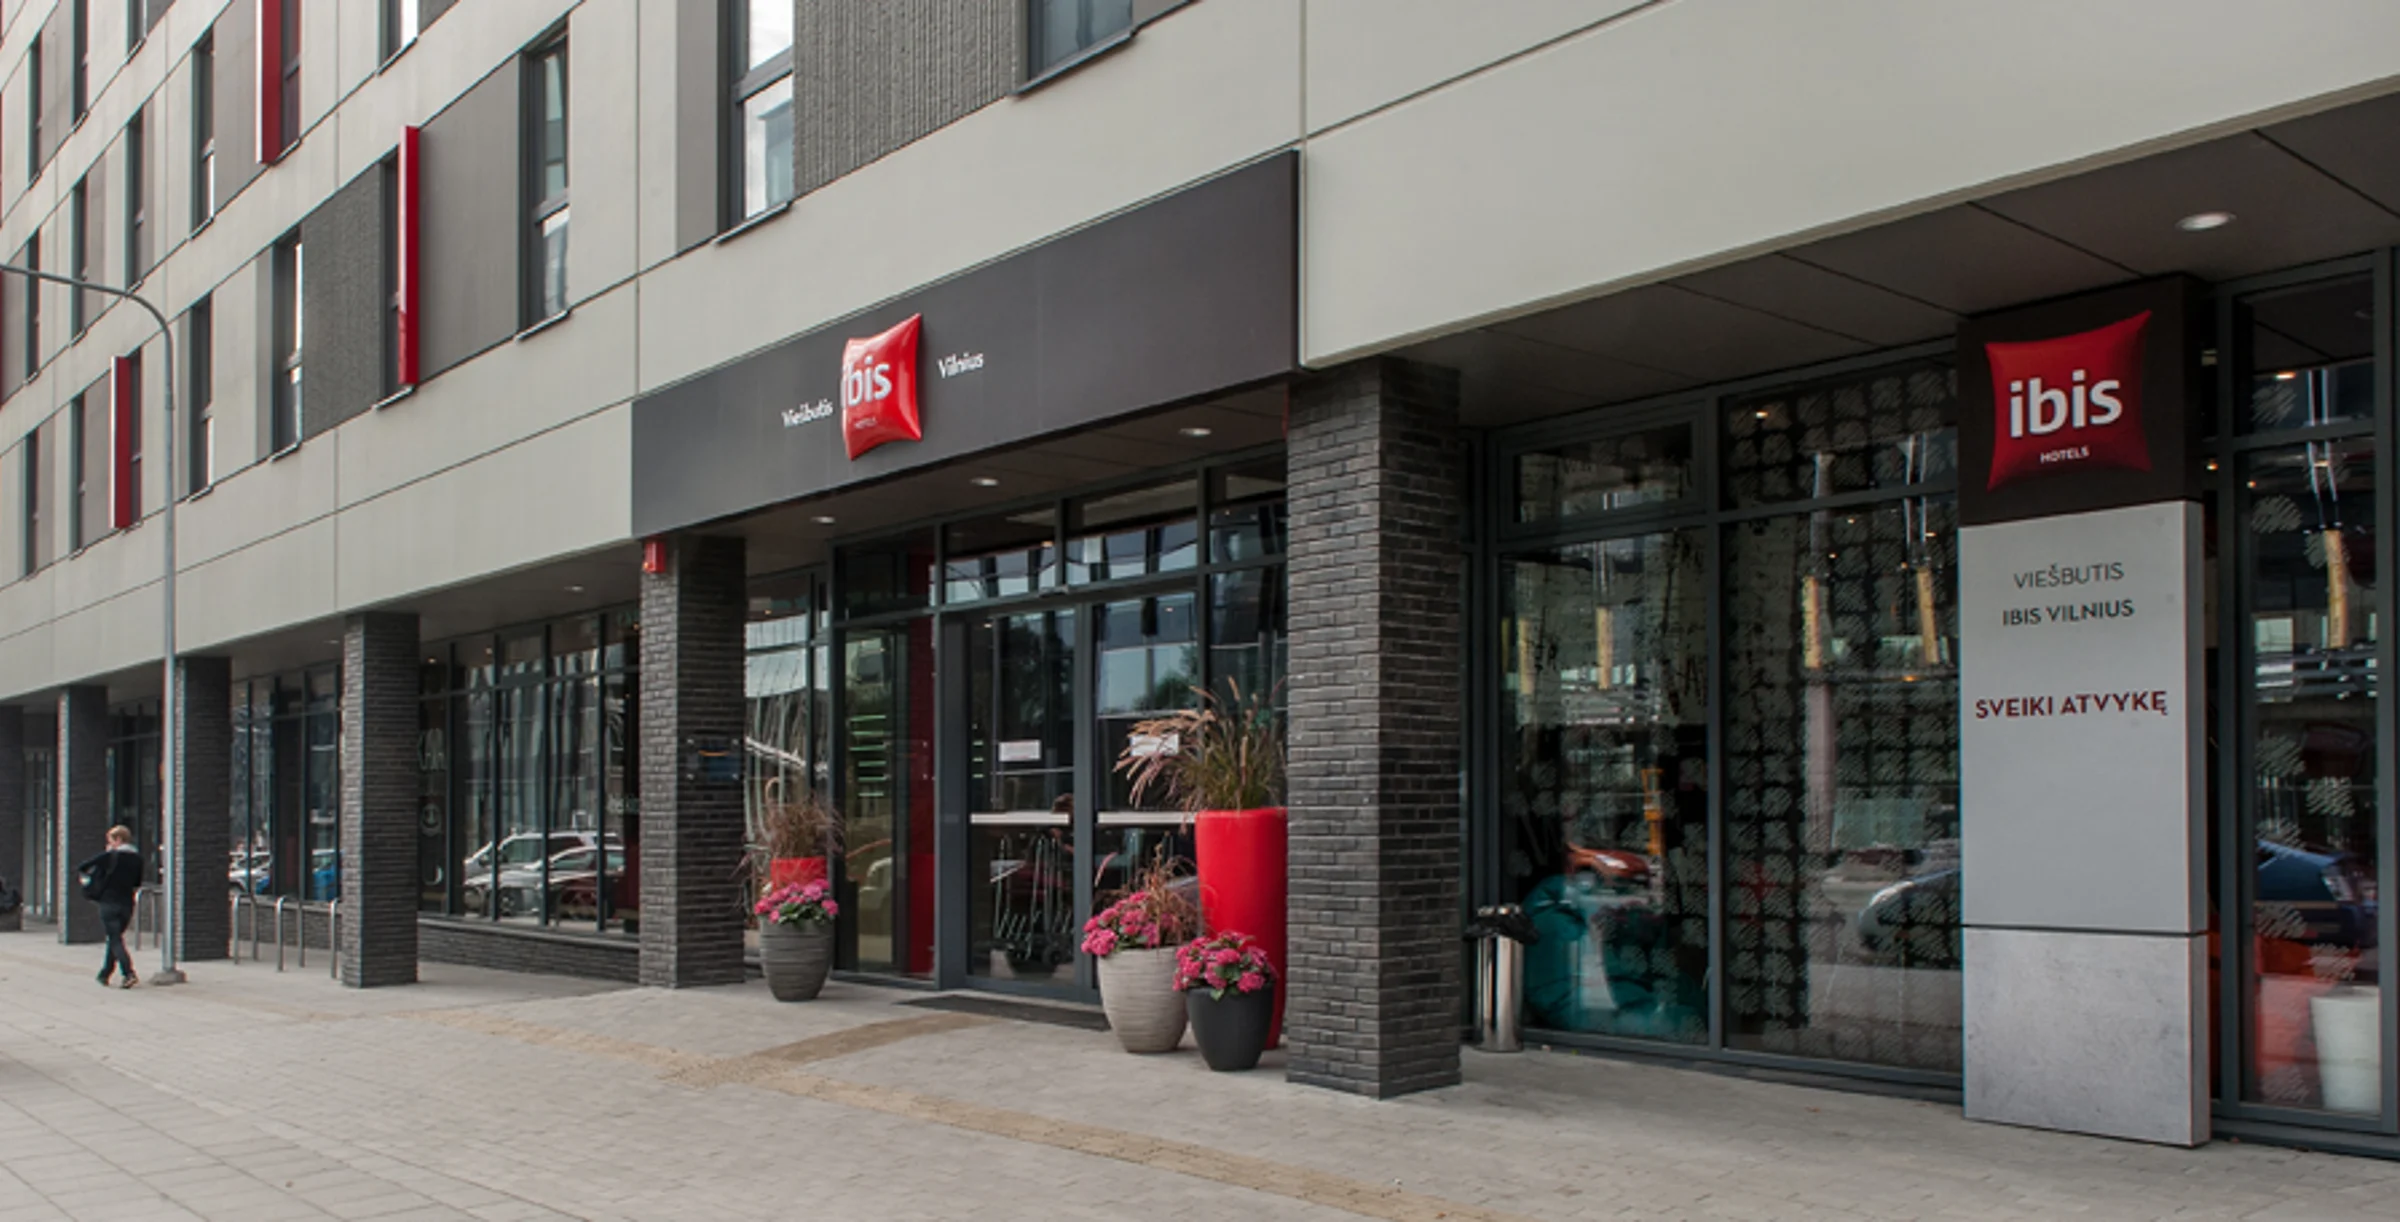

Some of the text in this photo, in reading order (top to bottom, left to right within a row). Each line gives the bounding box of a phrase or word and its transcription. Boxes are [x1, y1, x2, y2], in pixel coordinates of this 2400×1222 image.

[937, 351, 984, 379] Vilnius
[2010, 369, 2123, 438] ibis
[2040, 445, 2090, 464] HOTELS
[2013, 562, 2125, 590] VIEŠBUTIS
[2002, 599, 2136, 626] IBIS VILNIUS
[1975, 690, 2169, 719] SVEIKI ATVYKĘ
